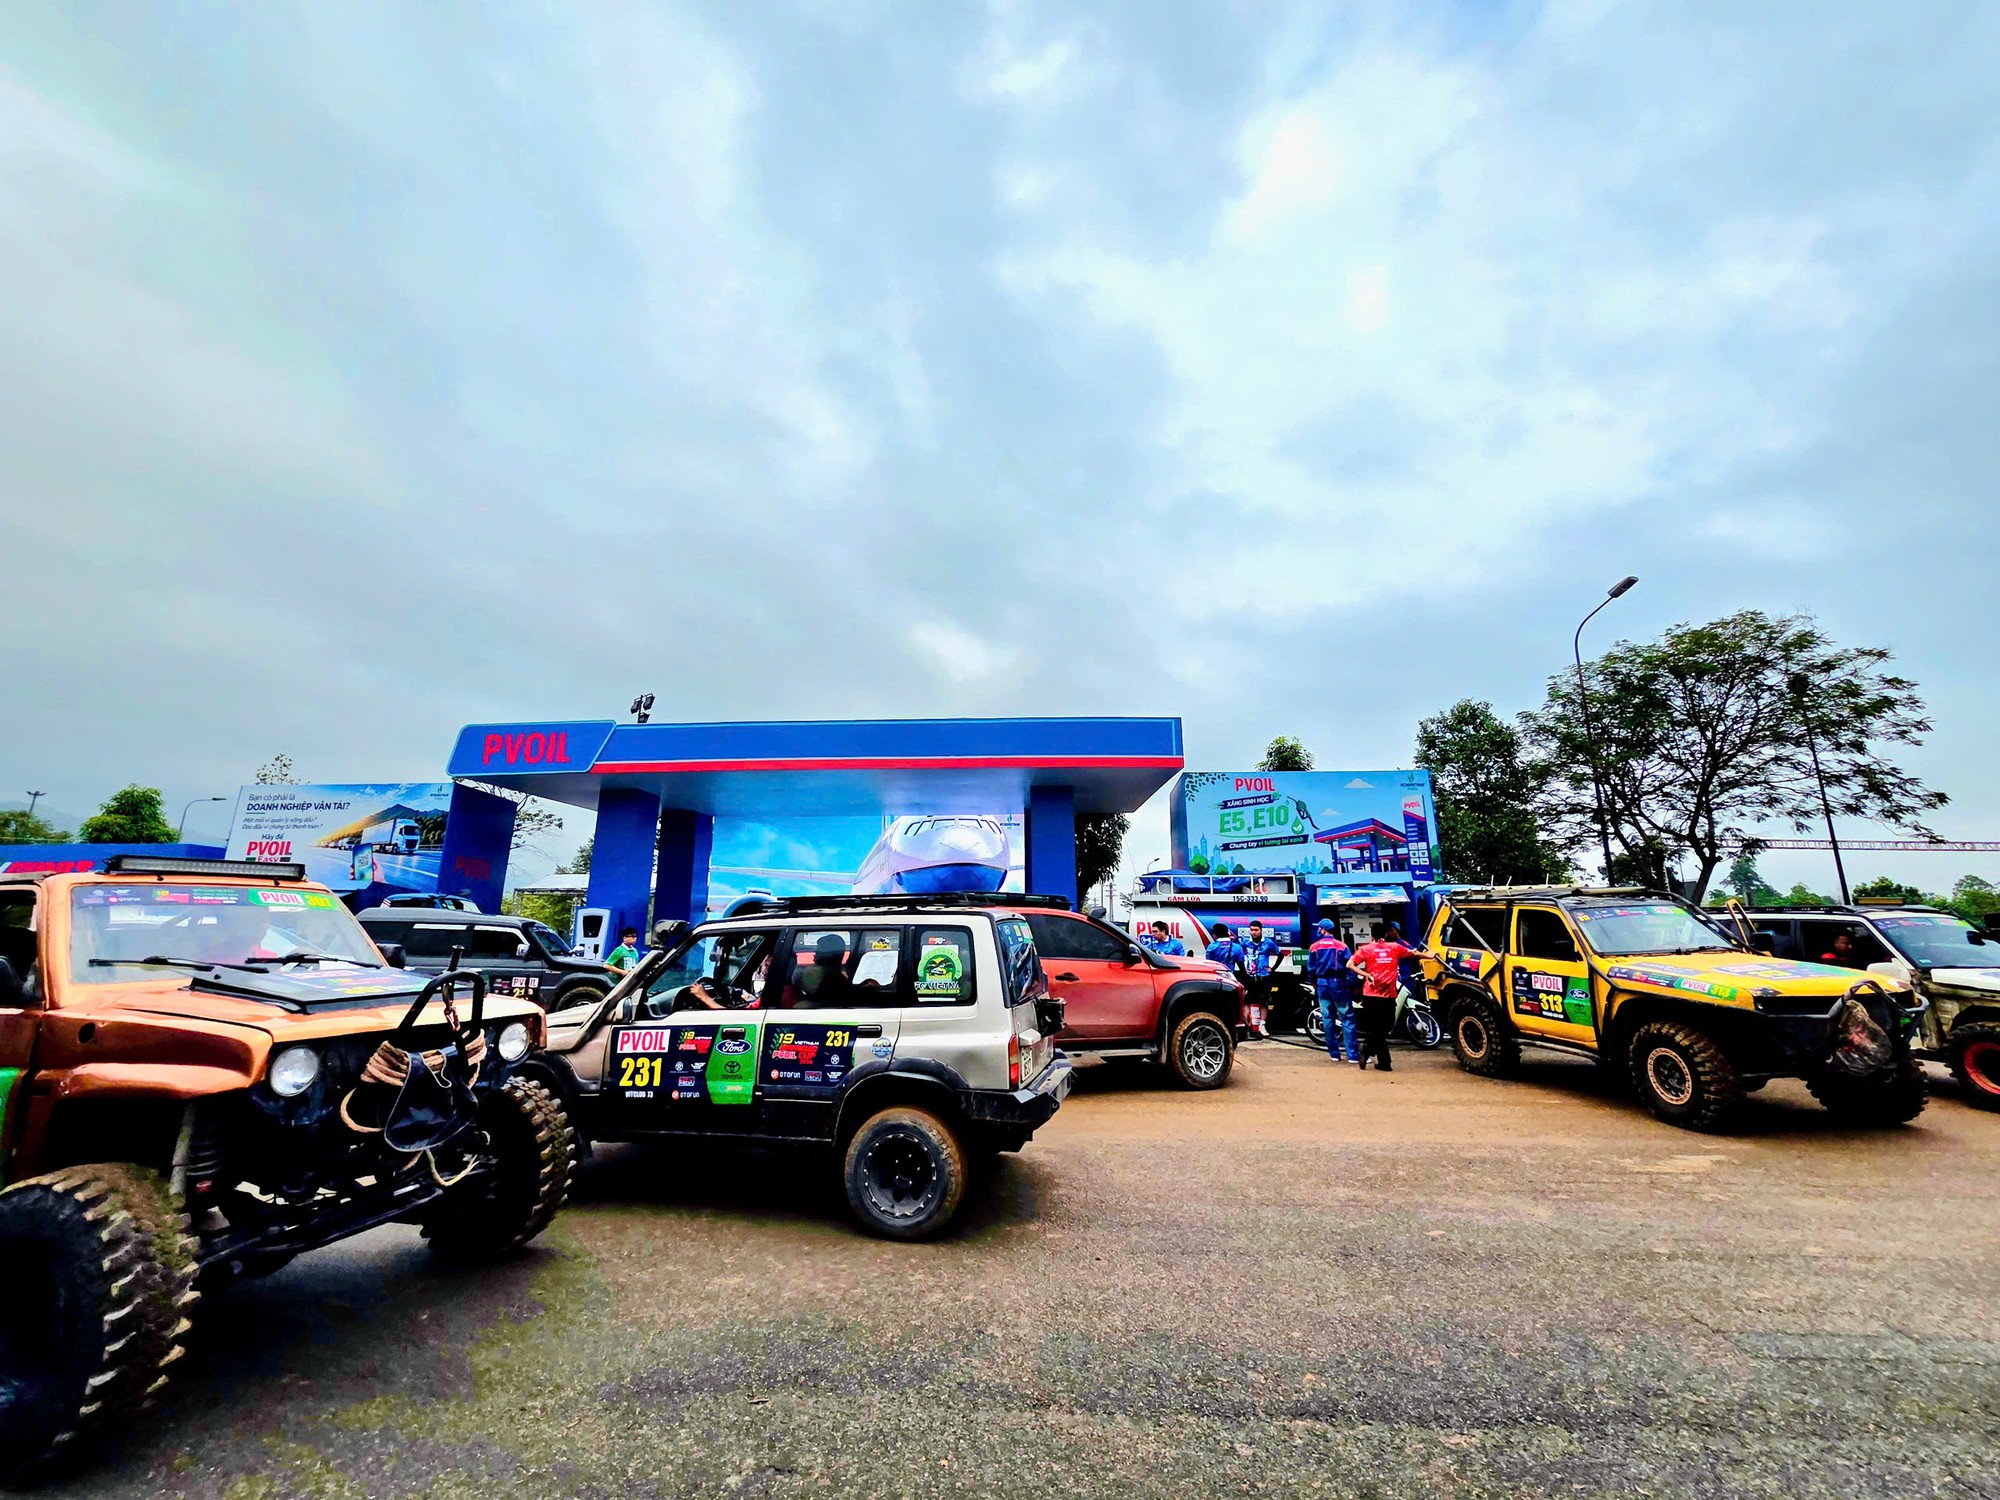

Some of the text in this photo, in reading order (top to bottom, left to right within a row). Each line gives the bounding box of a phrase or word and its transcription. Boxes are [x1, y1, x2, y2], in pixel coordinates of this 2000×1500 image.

[482, 732, 571, 765] PVOIL
[1234, 778, 1275, 792] PVOIL
[249, 794, 262, 802] Bạn
[272, 794, 288, 802] phải
[1257, 796, 1270, 804] HỌC
[246, 801, 351, 812] DOANH NGHIỆP VẬN TẢI?
[261, 832, 285, 841] Hãy để
[246, 841, 292, 856] PVOIL
[1229, 842, 1248, 850] Chung
[260, 892, 300, 904] PVOIL
[513, 978, 536, 986] PVIL
[1533, 975, 1561, 991] PVOIL
[1682, 979, 1707, 992] PVOIL
[1573, 990, 1587, 999] Ford
[1539, 992, 1563, 1013] 313
[619, 1031, 666, 1051] PVOIL
[684, 1031, 695, 1040] 19
[778, 1033, 795, 1044] 19
[825, 1030, 850, 1047] 231
[722, 1041, 745, 1052] Ford
[772, 1050, 797, 1059] PVOIL
[619, 1057, 662, 1087] 231
